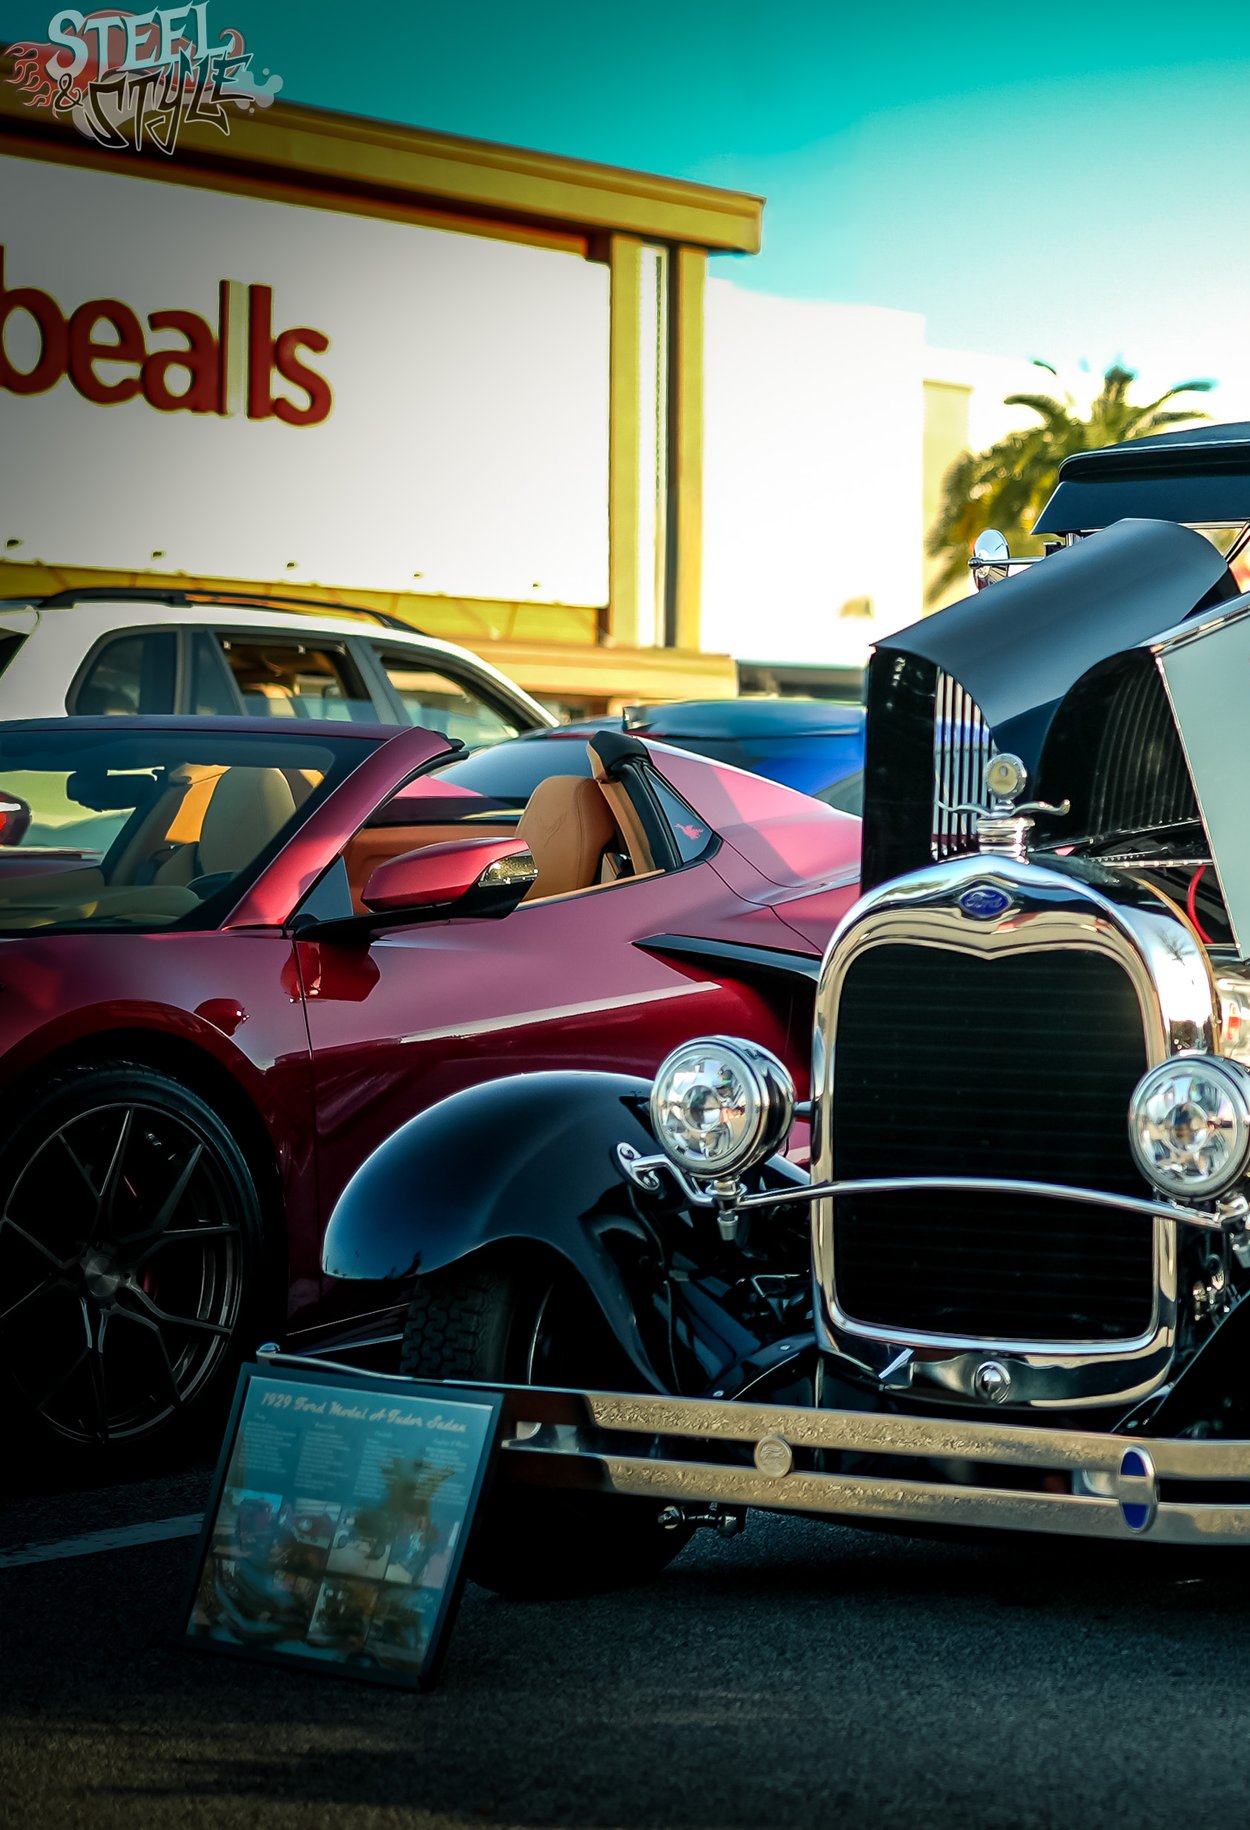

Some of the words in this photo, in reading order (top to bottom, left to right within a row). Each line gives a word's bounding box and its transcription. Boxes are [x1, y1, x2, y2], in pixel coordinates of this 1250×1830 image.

[0, 244, 333, 428] bealls
[964, 891, 1002, 909] Ford
[261, 1392, 292, 1408] 1929
[294, 1397, 326, 1414] Ford
[329, 1401, 369, 1420] Model
[369, 1408, 386, 1422] A
[387, 1409, 422, 1427] Tudor
[427, 1415, 467, 1433] Sedan
